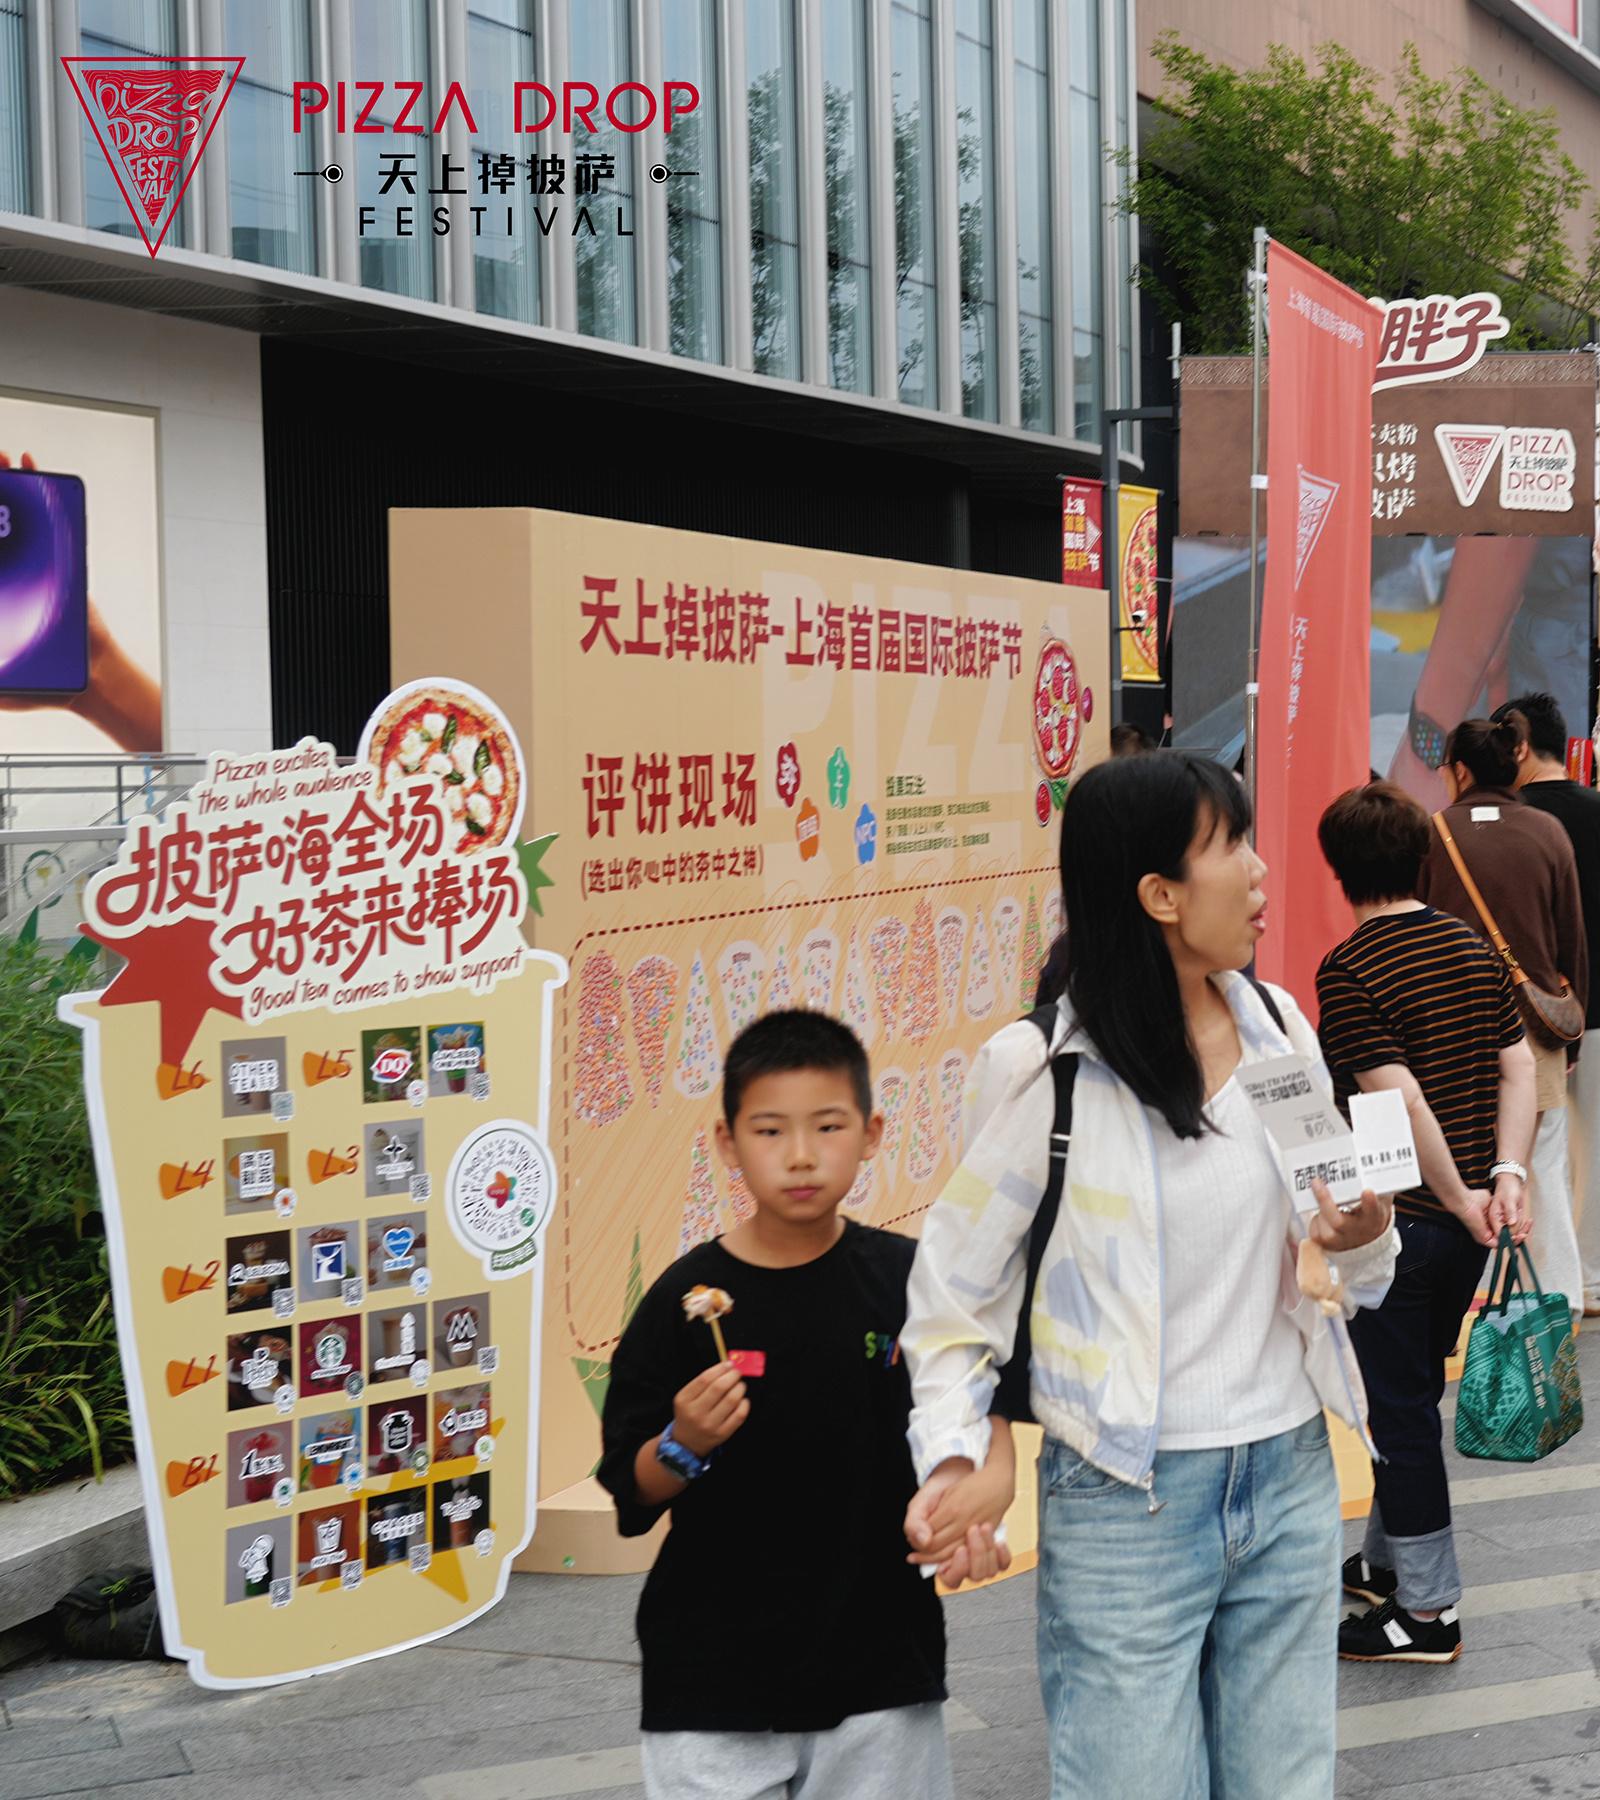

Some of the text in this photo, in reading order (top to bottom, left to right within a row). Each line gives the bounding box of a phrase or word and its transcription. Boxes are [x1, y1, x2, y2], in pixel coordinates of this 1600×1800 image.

[1509, 434, 1569, 454] PIZZA
[1507, 472, 1568, 492] DROP
[579, 574, 1023, 681] 天上掉披萨-上海首届国际披萨节
[213, 745, 330, 785] Pizza excites
[198, 768, 373, 816] the whole audience
[581, 752, 758, 839] 评饼现场
[96, 783, 444, 928] 披萨嗨全场
[219, 855, 521, 985] 好茶来捧场
[250, 945, 525, 1019] good tea comes to show support
[171, 1061, 206, 1092] L6
[316, 1048, 356, 1079] L5
[380, 1056, 406, 1075] DQ
[175, 1158, 216, 1192] L4
[321, 1144, 360, 1178] L3
[178, 1259, 222, 1295] L2
[182, 1353, 218, 1389] L1
[182, 1452, 219, 1490] B1
